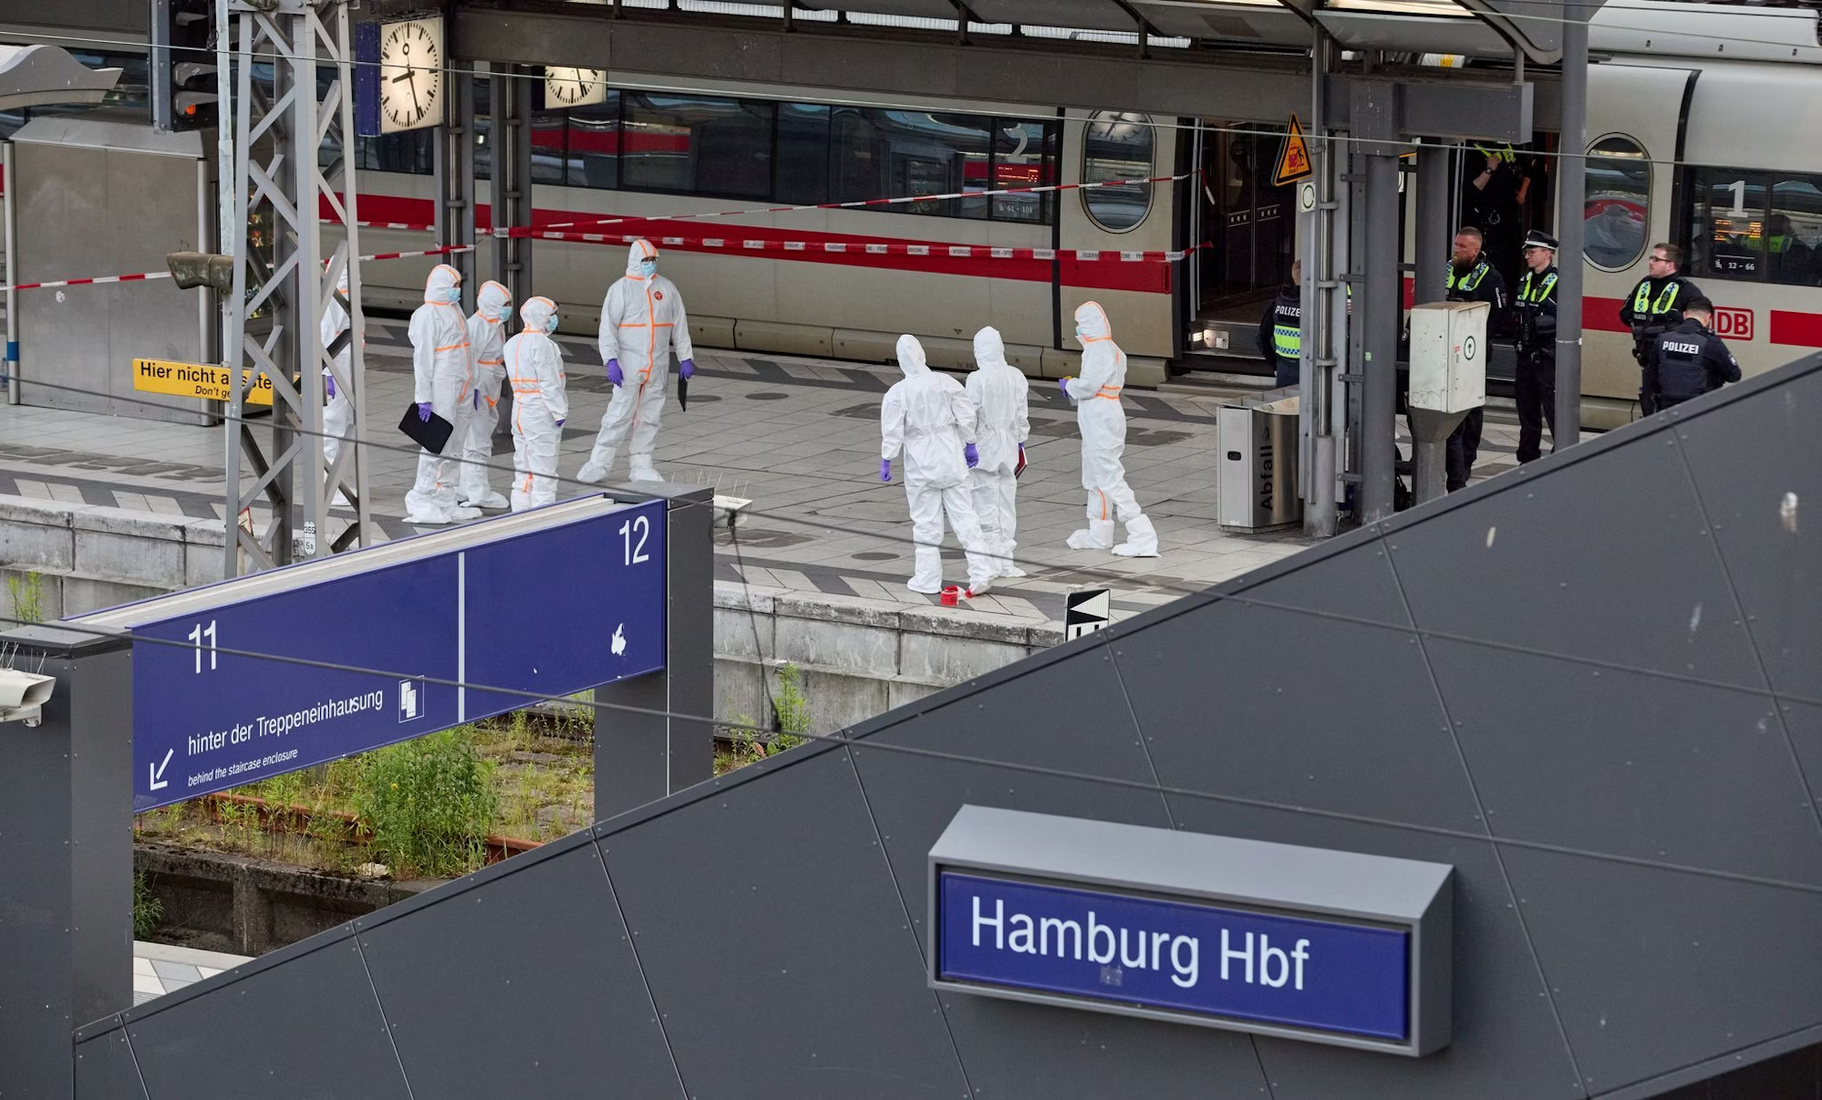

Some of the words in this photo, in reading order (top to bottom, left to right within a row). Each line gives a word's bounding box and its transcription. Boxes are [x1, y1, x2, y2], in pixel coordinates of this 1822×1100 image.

[1002, 122, 1028, 164] 2
[1727, 180, 1749, 218] 1
[1275, 305, 1300, 317] POLIZE
[1717, 312, 1749, 335] DB
[1662, 340, 1700, 355] POLIZEI
[141, 361, 172, 379] Hier
[177, 368, 215, 384] nicht
[195, 385, 219, 396] Don't
[1260, 445, 1273, 511] Abfall
[619, 515, 649, 566] 12
[188, 619, 216, 674] 11
[188, 730, 228, 756] hinter
[230, 723, 253, 745] der
[256, 690, 383, 737] Treppeneinhausung
[188, 769, 214, 787] behind
[215, 768, 227, 780] the
[228, 759, 261, 776] staircase
[262, 748, 298, 767] enclosure
[972, 896, 1199, 988] Hamburg
[1220, 928, 1310, 990] Hbf
